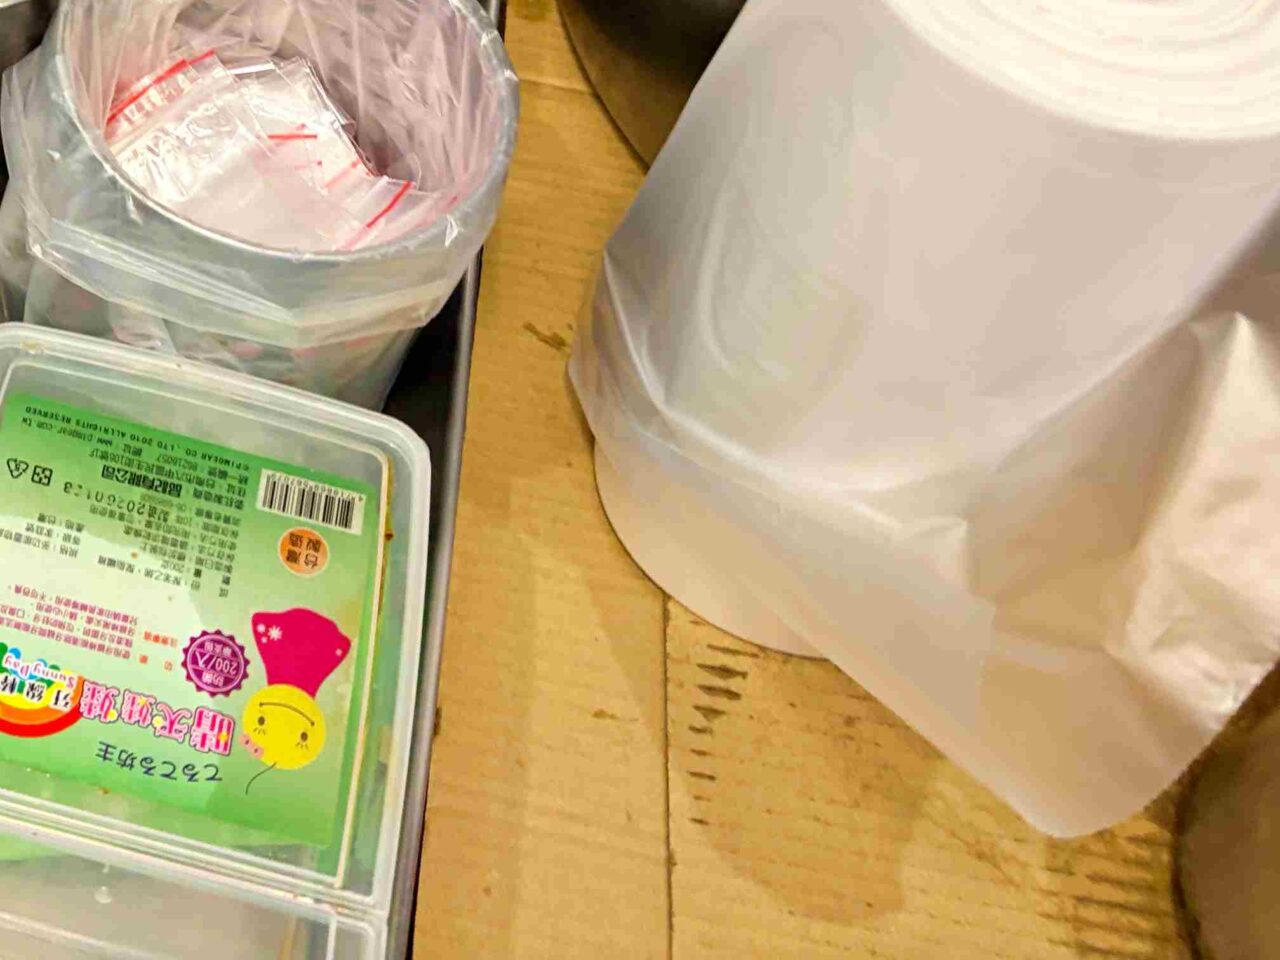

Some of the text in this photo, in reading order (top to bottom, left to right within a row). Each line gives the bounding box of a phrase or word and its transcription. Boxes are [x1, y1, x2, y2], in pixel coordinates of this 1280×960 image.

[287, 532, 321, 552] 製造
[285, 548, 318, 569] 台灣
[192, 650, 238, 675] 200/入
[75, 679, 237, 757] 晴天娃娃
[94, 739, 224, 783] てるてる坊主
